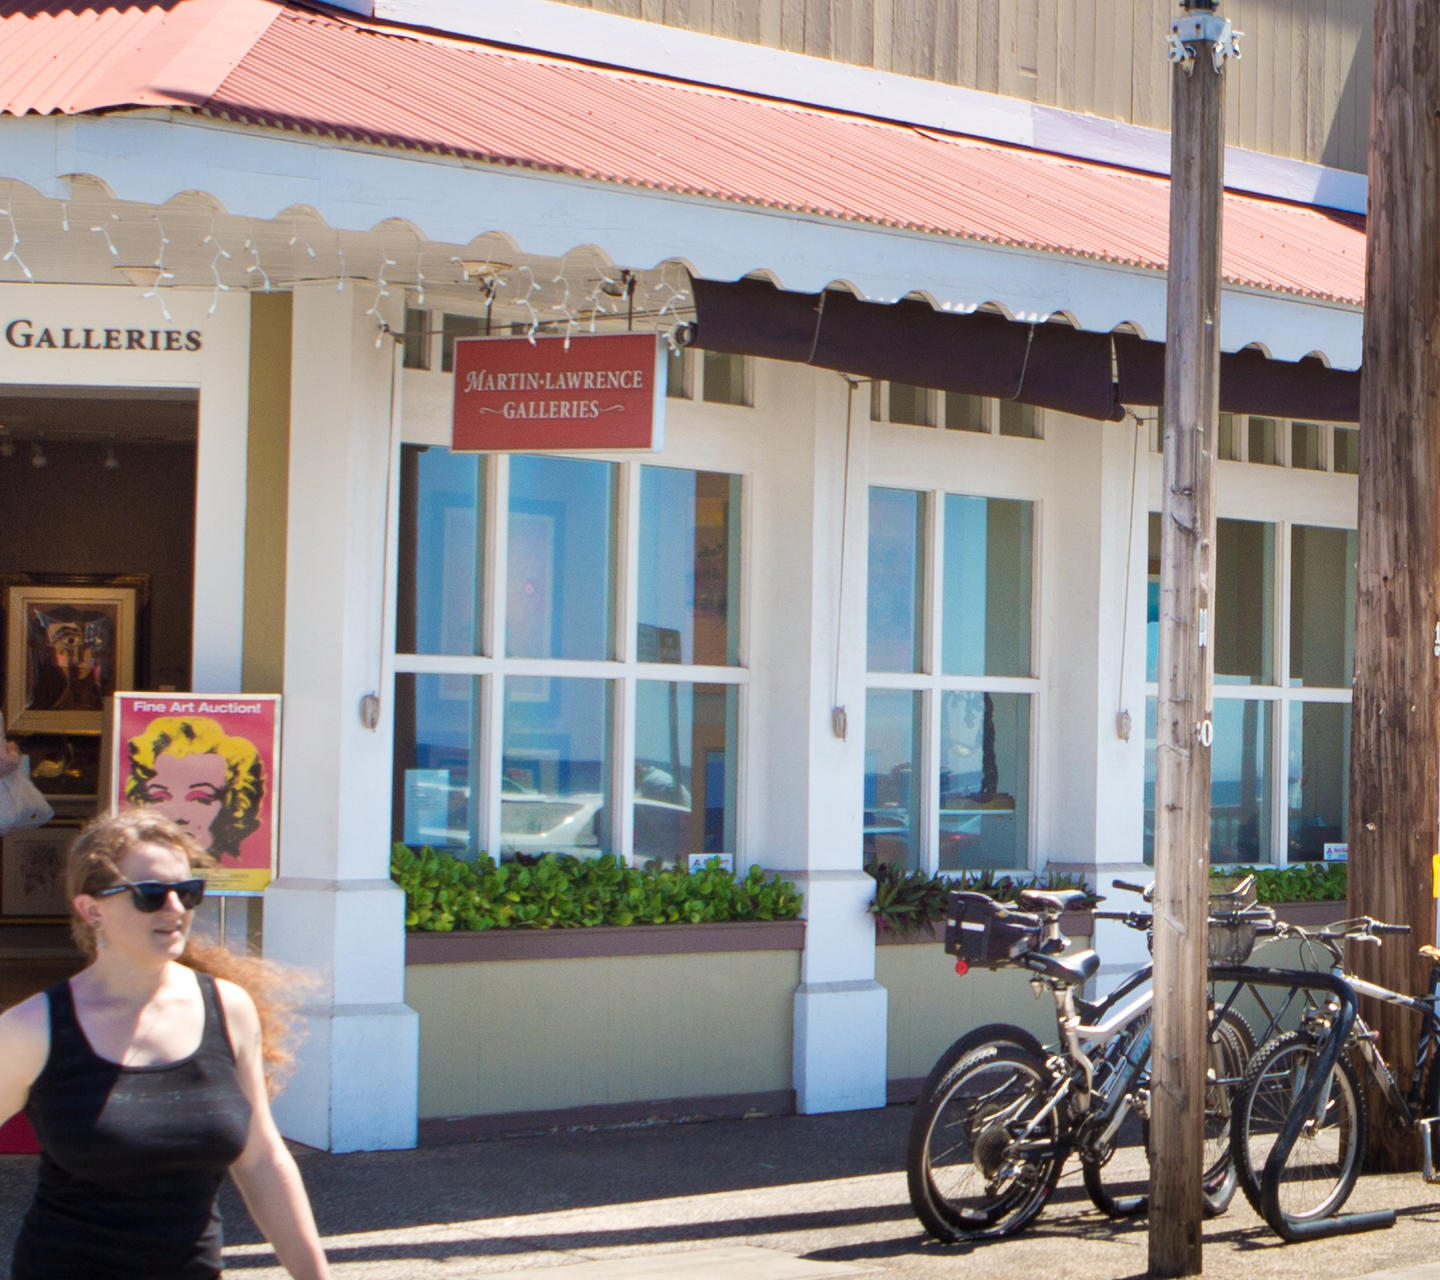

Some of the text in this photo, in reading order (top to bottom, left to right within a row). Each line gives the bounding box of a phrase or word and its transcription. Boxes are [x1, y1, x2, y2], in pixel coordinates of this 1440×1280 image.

[4, 318, 203, 352] GALLERIES
[502, 400, 600, 419] GALLERIES
[133, 701, 262, 714] Fine Art Auction!
